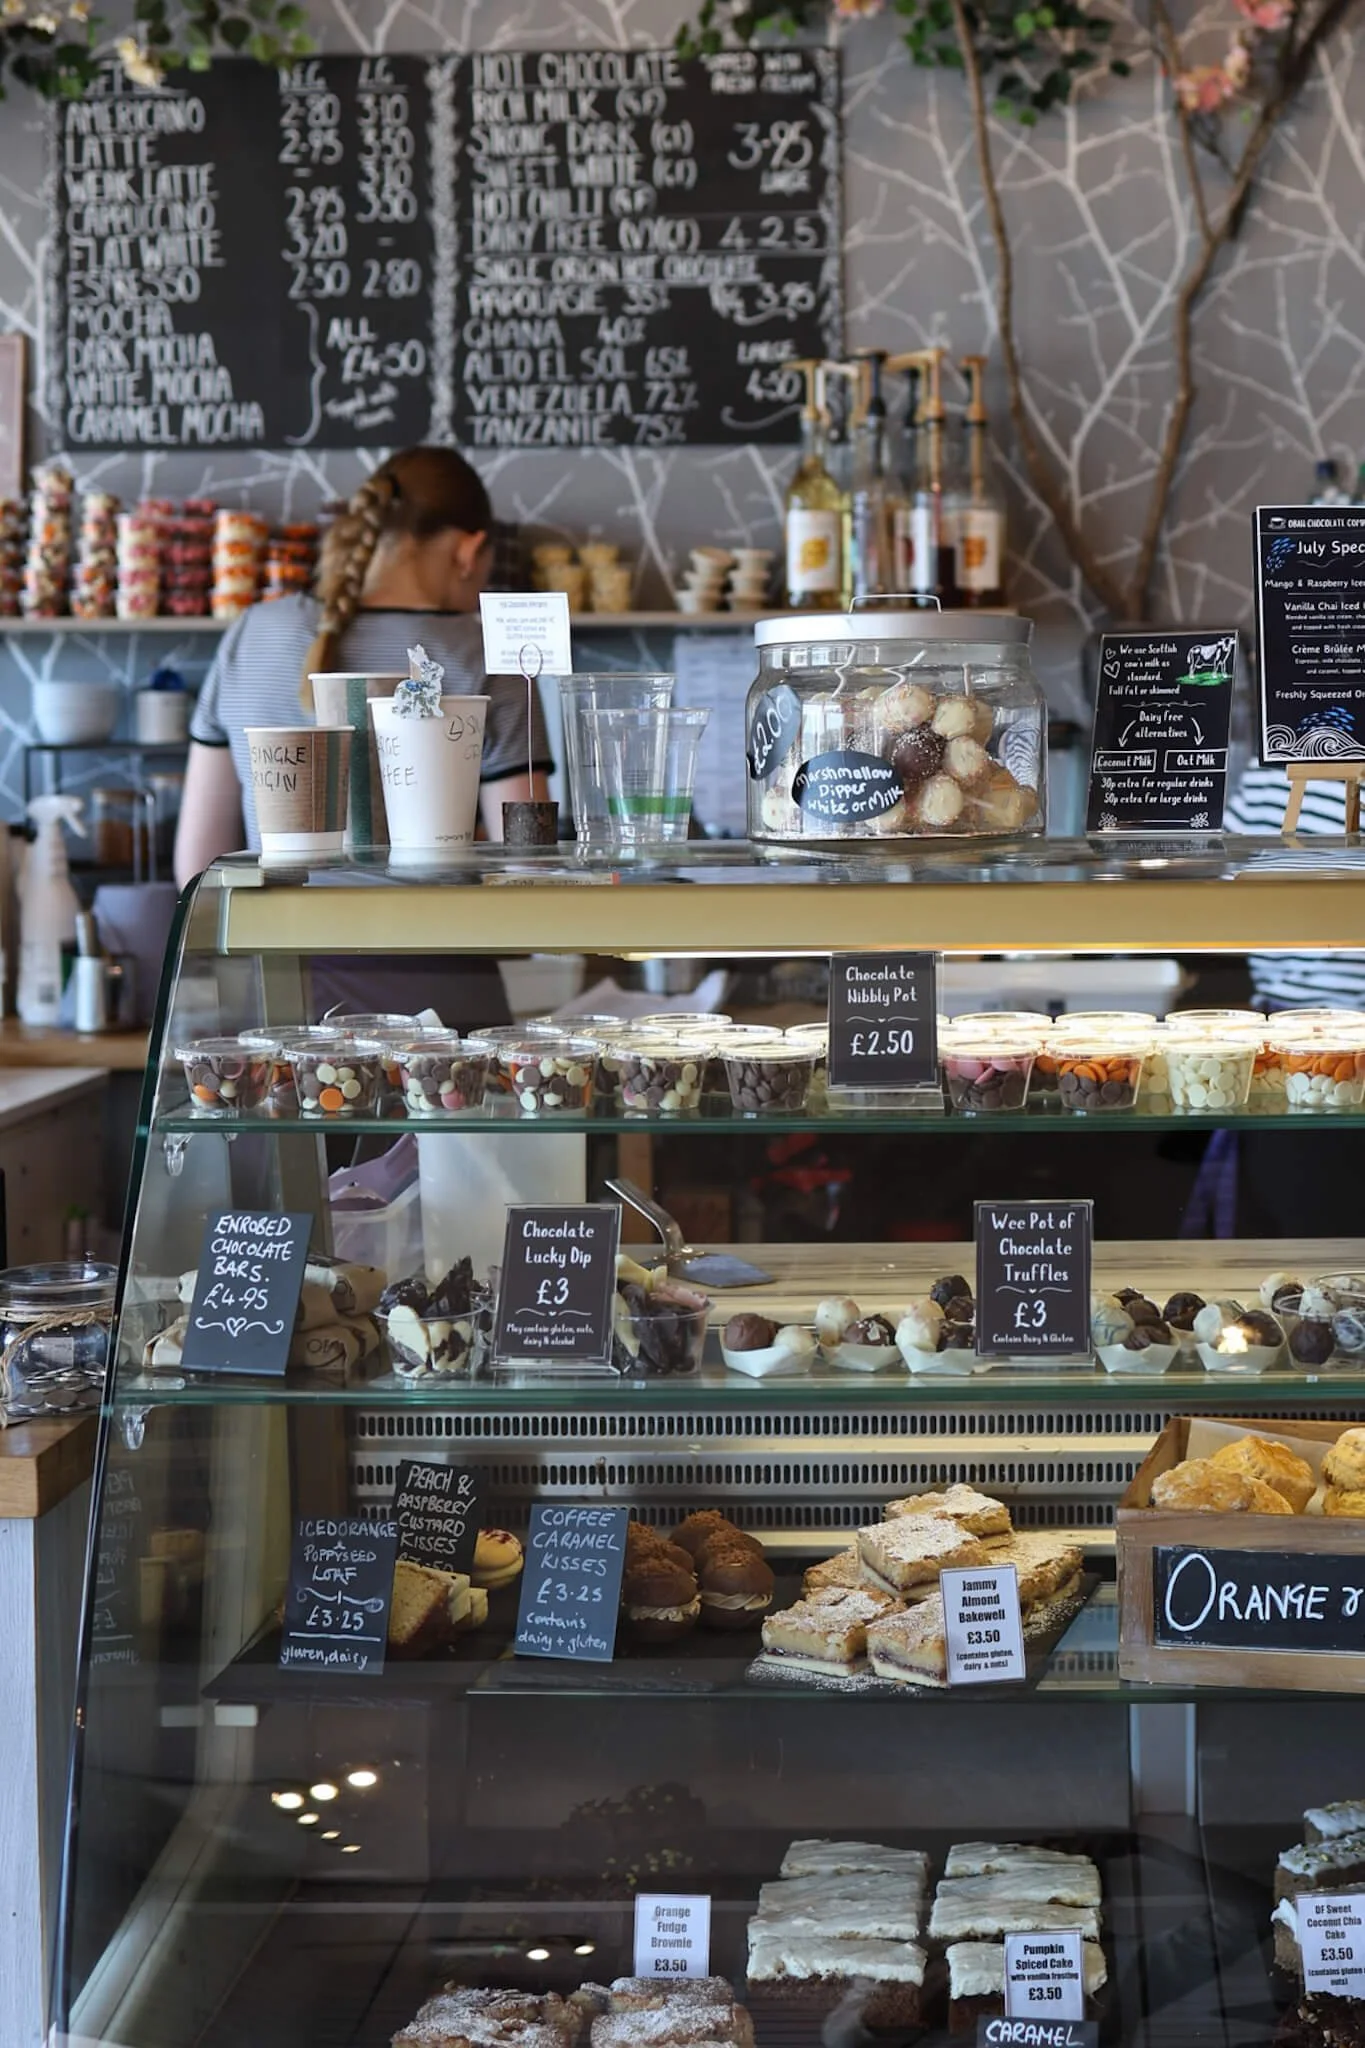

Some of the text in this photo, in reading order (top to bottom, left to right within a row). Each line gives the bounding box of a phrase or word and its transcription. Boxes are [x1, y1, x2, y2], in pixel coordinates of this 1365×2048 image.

[65, 135, 160, 170] LATTE
[1297, 540, 1365, 557] July Spec
[1264, 579, 1348, 590] Mango Raspberry
[1284, 601, 1360, 611] Vanilla Chai Iced
[1120, 644, 1132, 654] We
[1148, 643, 1177, 654] Scottish
[1291, 643, 1353, 654] Crème Brûlée
[1144, 658, 1160, 668] milk
[1108, 686, 1124, 695] Full
[1149, 685, 1181, 695] skimmed
[1275, 689, 1352, 701] Freshly Squeezed
[1139, 710, 1162, 724] Dairy
[1135, 727, 1188, 738] alternatives
[251, 746, 307, 766] SINGLE
[1098, 754, 1152, 767] Coconut Milk
[1177, 754, 1215, 766] Oat Milk
[796, 766, 893, 787] Marshmallow
[1101, 776, 1214, 790] 30p extra for regular drinks
[818, 783, 867, 798] Dipper
[808, 786, 905, 815] White or Milk
[1104, 792, 1208, 806] 50p extra for large drinks
[846, 965, 915, 981] Chocolate
[847, 986, 918, 1006] Nibbly Pot
[850, 1030, 914, 1056] £2.50
[214, 1215, 292, 1236] ENROBED
[991, 1212, 1075, 1230] Wee Pot of
[523, 1220, 595, 1238] Chocolate
[211, 1238, 294, 1261] CHOCOLATE
[999, 1237, 1072, 1256] Chocolate
[525, 1246, 592, 1269] Lucky Dip
[1004, 1263, 1069, 1282] Truffles
[536, 1277, 570, 1305] £3
[1013, 1299, 1047, 1328] £3
[405, 1464, 475, 1496] PEACH &
[397, 1491, 477, 1517] RASPBERRY
[398, 1511, 465, 1537] CUSTARD
[541, 1508, 616, 1527] COFFEE
[400, 1531, 458, 1554] KISSES
[532, 1531, 621, 1551] CARAMEL
[540, 1553, 608, 1577] KISSES
[312, 1564, 358, 1585] LOAF
[962, 1579, 998, 1592] Jammy
[1165, 1552, 1330, 1632] ORANGE
[962, 1594, 1001, 1608] Almond
[526, 1611, 587, 1630] contains
[959, 1609, 1006, 1624] Bakewell
[518, 1630, 608, 1655] dairy + gluten
[967, 1629, 1001, 1645] £3.50
[963, 1661, 982, 1671] dairy
[655, 1905, 691, 1919] Orange
[1326, 1904, 1352, 1914] Sweet
[657, 1921, 688, 1934] Fudge
[1307, 1916, 1362, 1928] Coconut Chia
[650, 1936, 693, 1949] Brownie
[1324, 1930, 1346, 1940] Cake
[1023, 1944, 1065, 1956] Pumpkin
[1320, 1947, 1354, 1961] £3.50
[654, 1958, 688, 1973] £3.50
[1015, 1958, 1074, 1970] Spiced Cake
[1011, 1973, 1026, 1981] with
[1027, 1972, 1051, 1981] vanilla
[1028, 1986, 1062, 2001] £3.50
[985, 2019, 1085, 2047] CARAMEL
